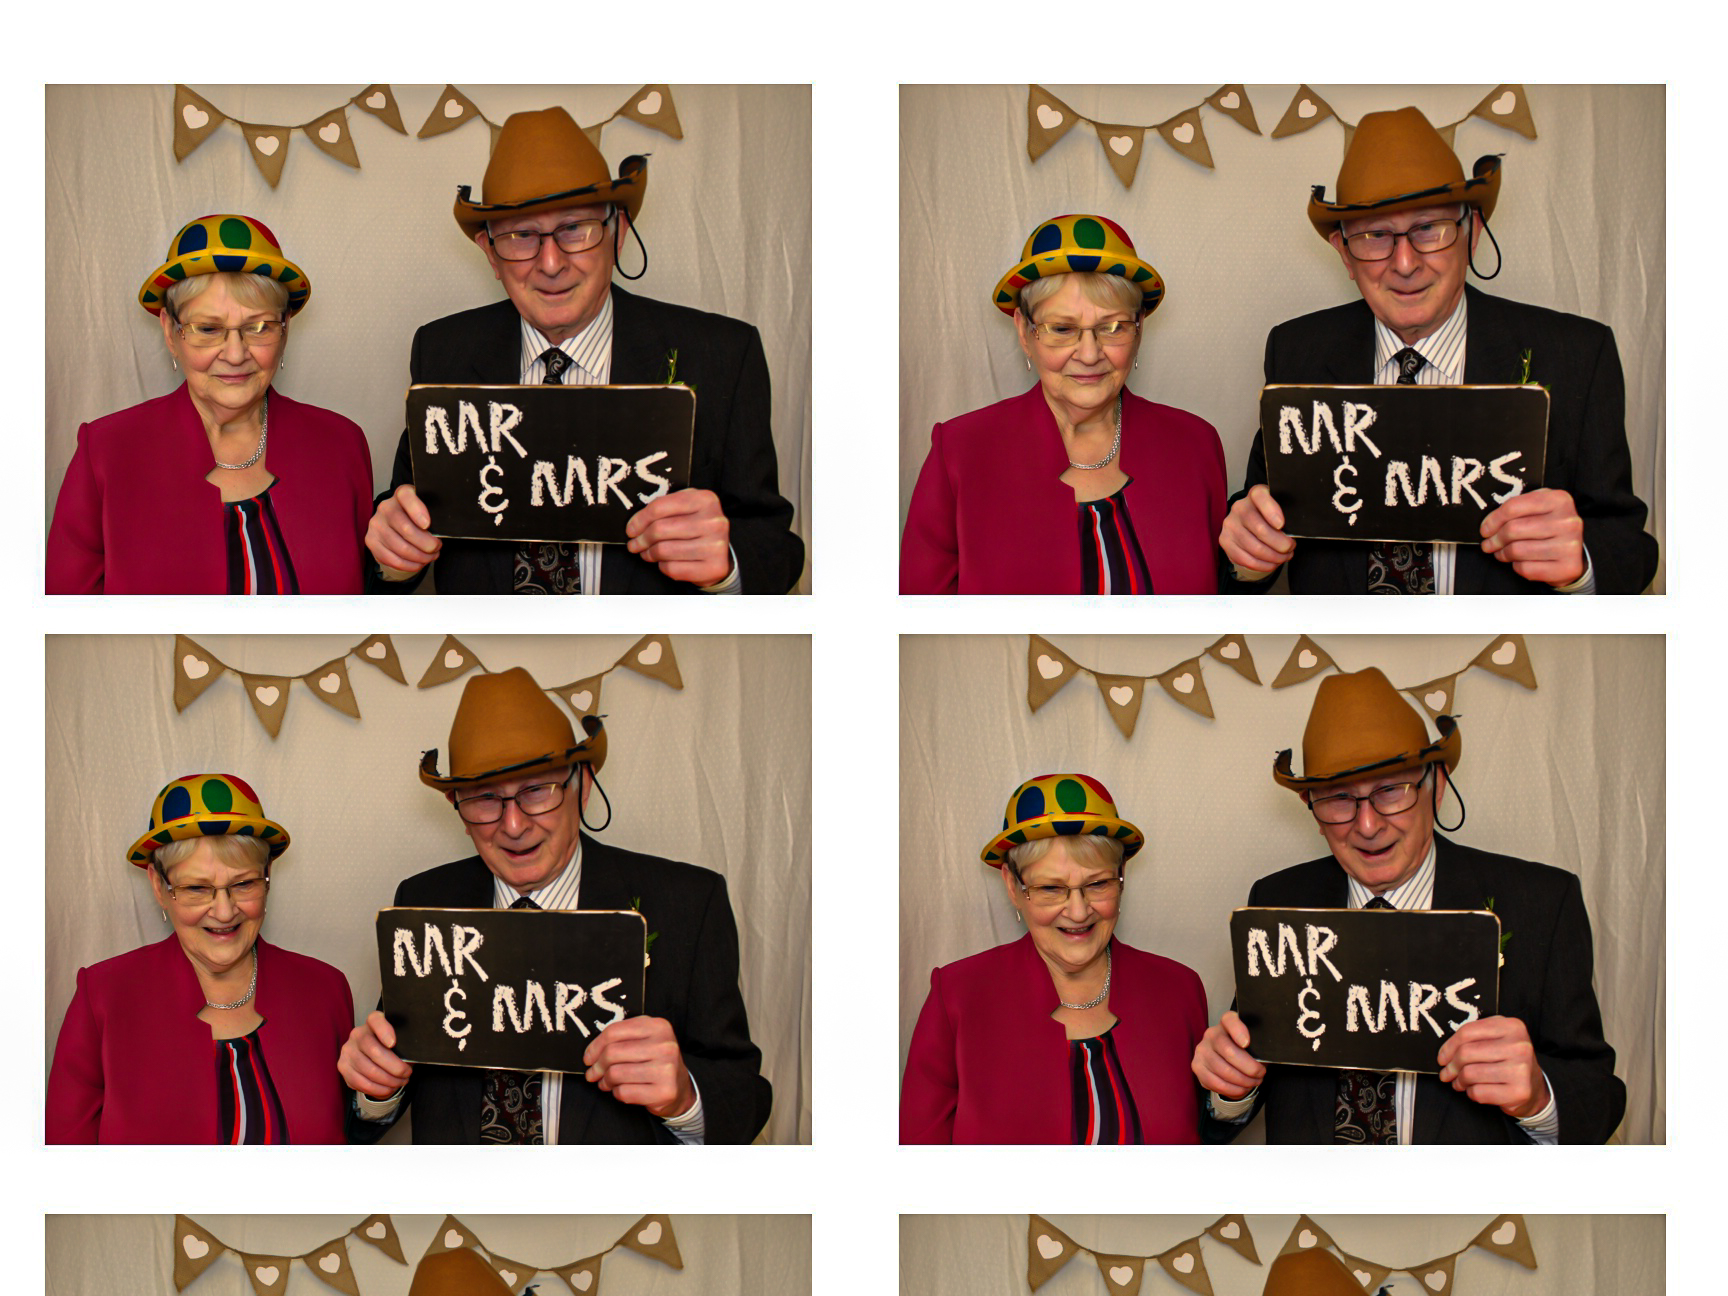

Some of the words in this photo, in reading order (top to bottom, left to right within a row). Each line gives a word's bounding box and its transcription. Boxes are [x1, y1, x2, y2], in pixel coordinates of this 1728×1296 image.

[424, 400, 528, 458] MR
[1278, 400, 1382, 458] MR
[478, 455, 509, 526] &
[530, 451, 672, 510] MRS
[1332, 455, 1363, 526] &
[1384, 451, 1526, 510] MRS
[393, 922, 489, 982] MR
[1247, 922, 1343, 982] MR
[442, 978, 472, 1052] &
[492, 977, 628, 1038] MRS
[1296, 978, 1326, 1052] &
[1346, 977, 1482, 1038] MRS
